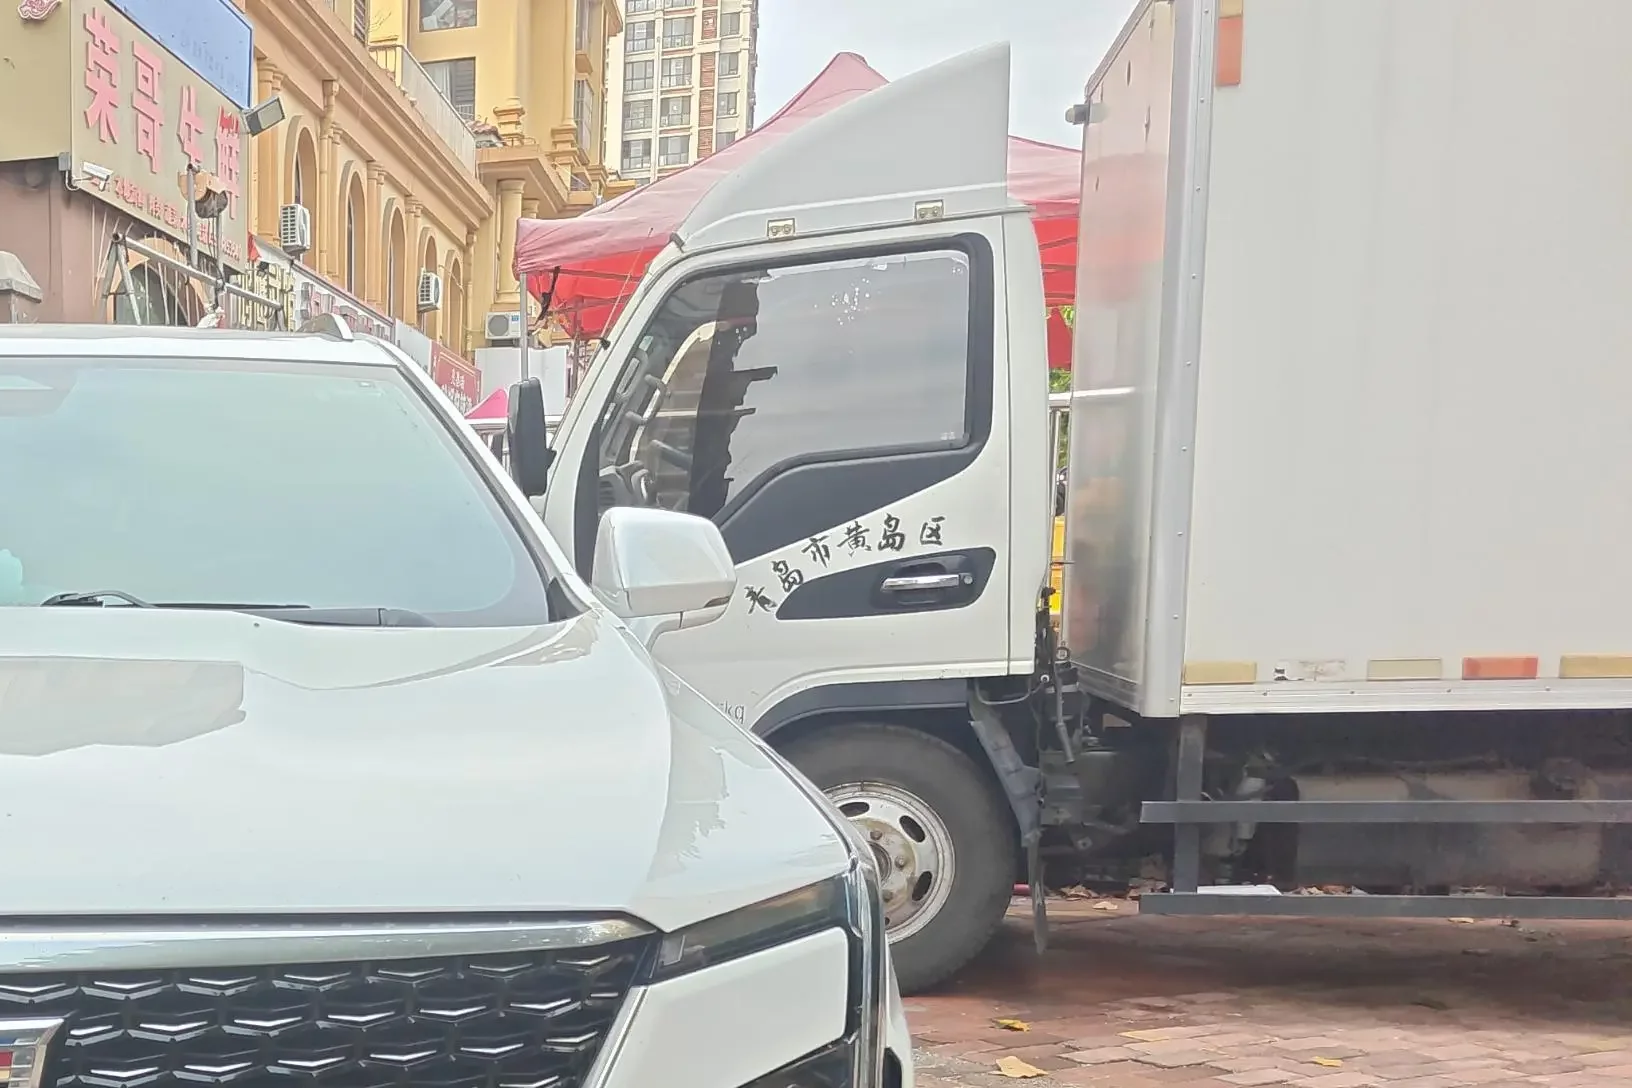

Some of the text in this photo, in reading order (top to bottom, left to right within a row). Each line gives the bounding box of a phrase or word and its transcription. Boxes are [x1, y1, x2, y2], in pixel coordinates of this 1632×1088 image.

[744, 513, 946, 614] 青岛市黄岛区
